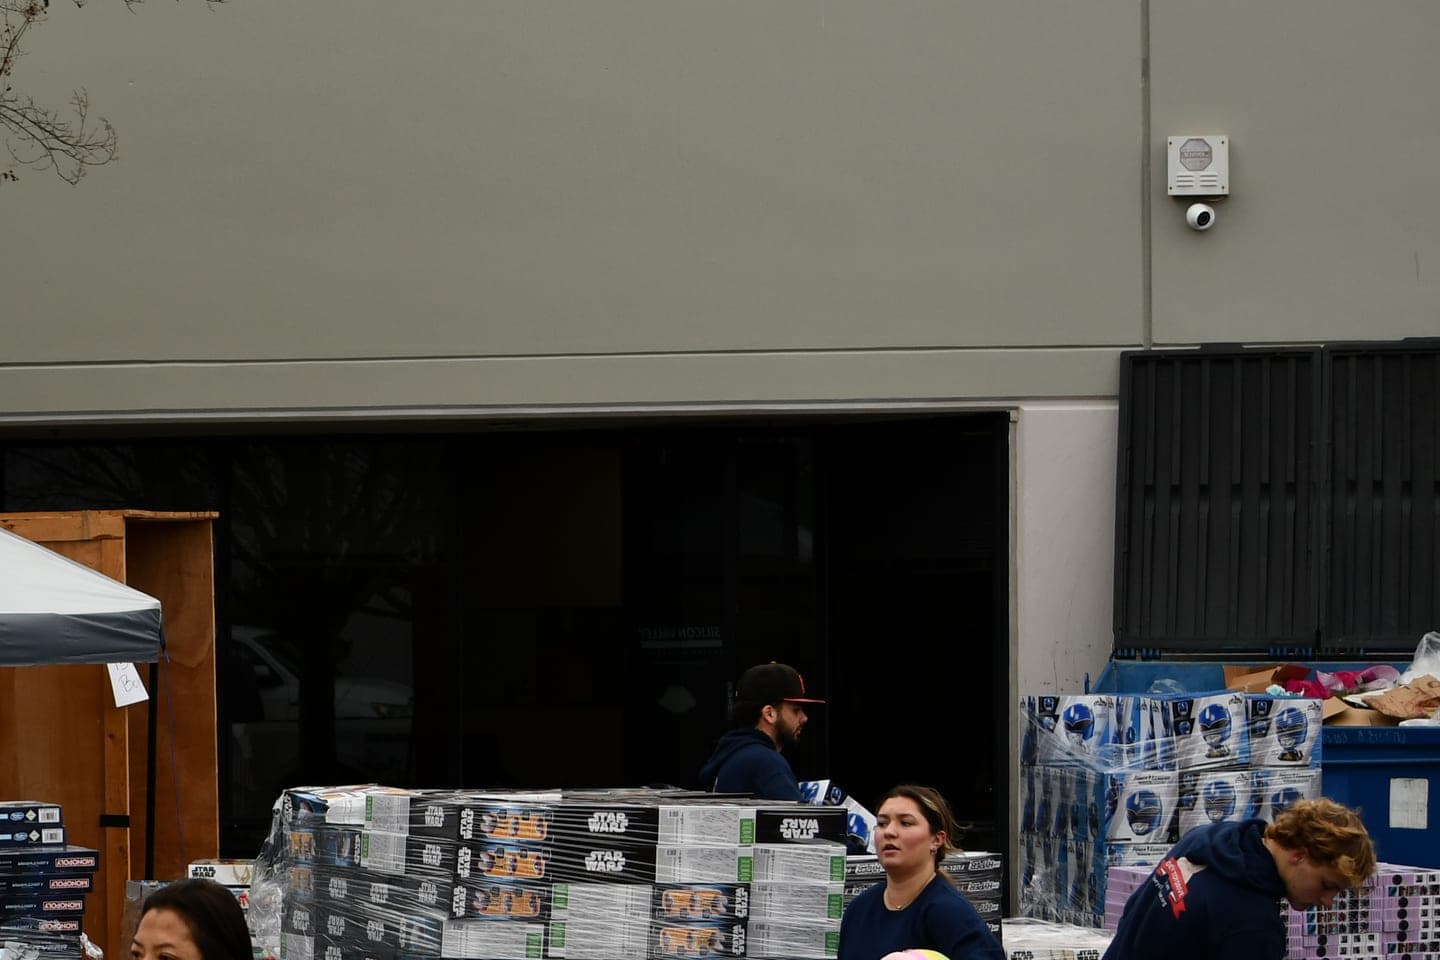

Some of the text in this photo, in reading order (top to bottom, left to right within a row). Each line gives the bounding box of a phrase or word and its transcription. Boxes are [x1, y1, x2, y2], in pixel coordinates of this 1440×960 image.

[56, 858, 94, 867] MONOPOLY
[51, 879, 88, 888] MONOPOLY
[44, 901, 81, 910] MONOPOLY
